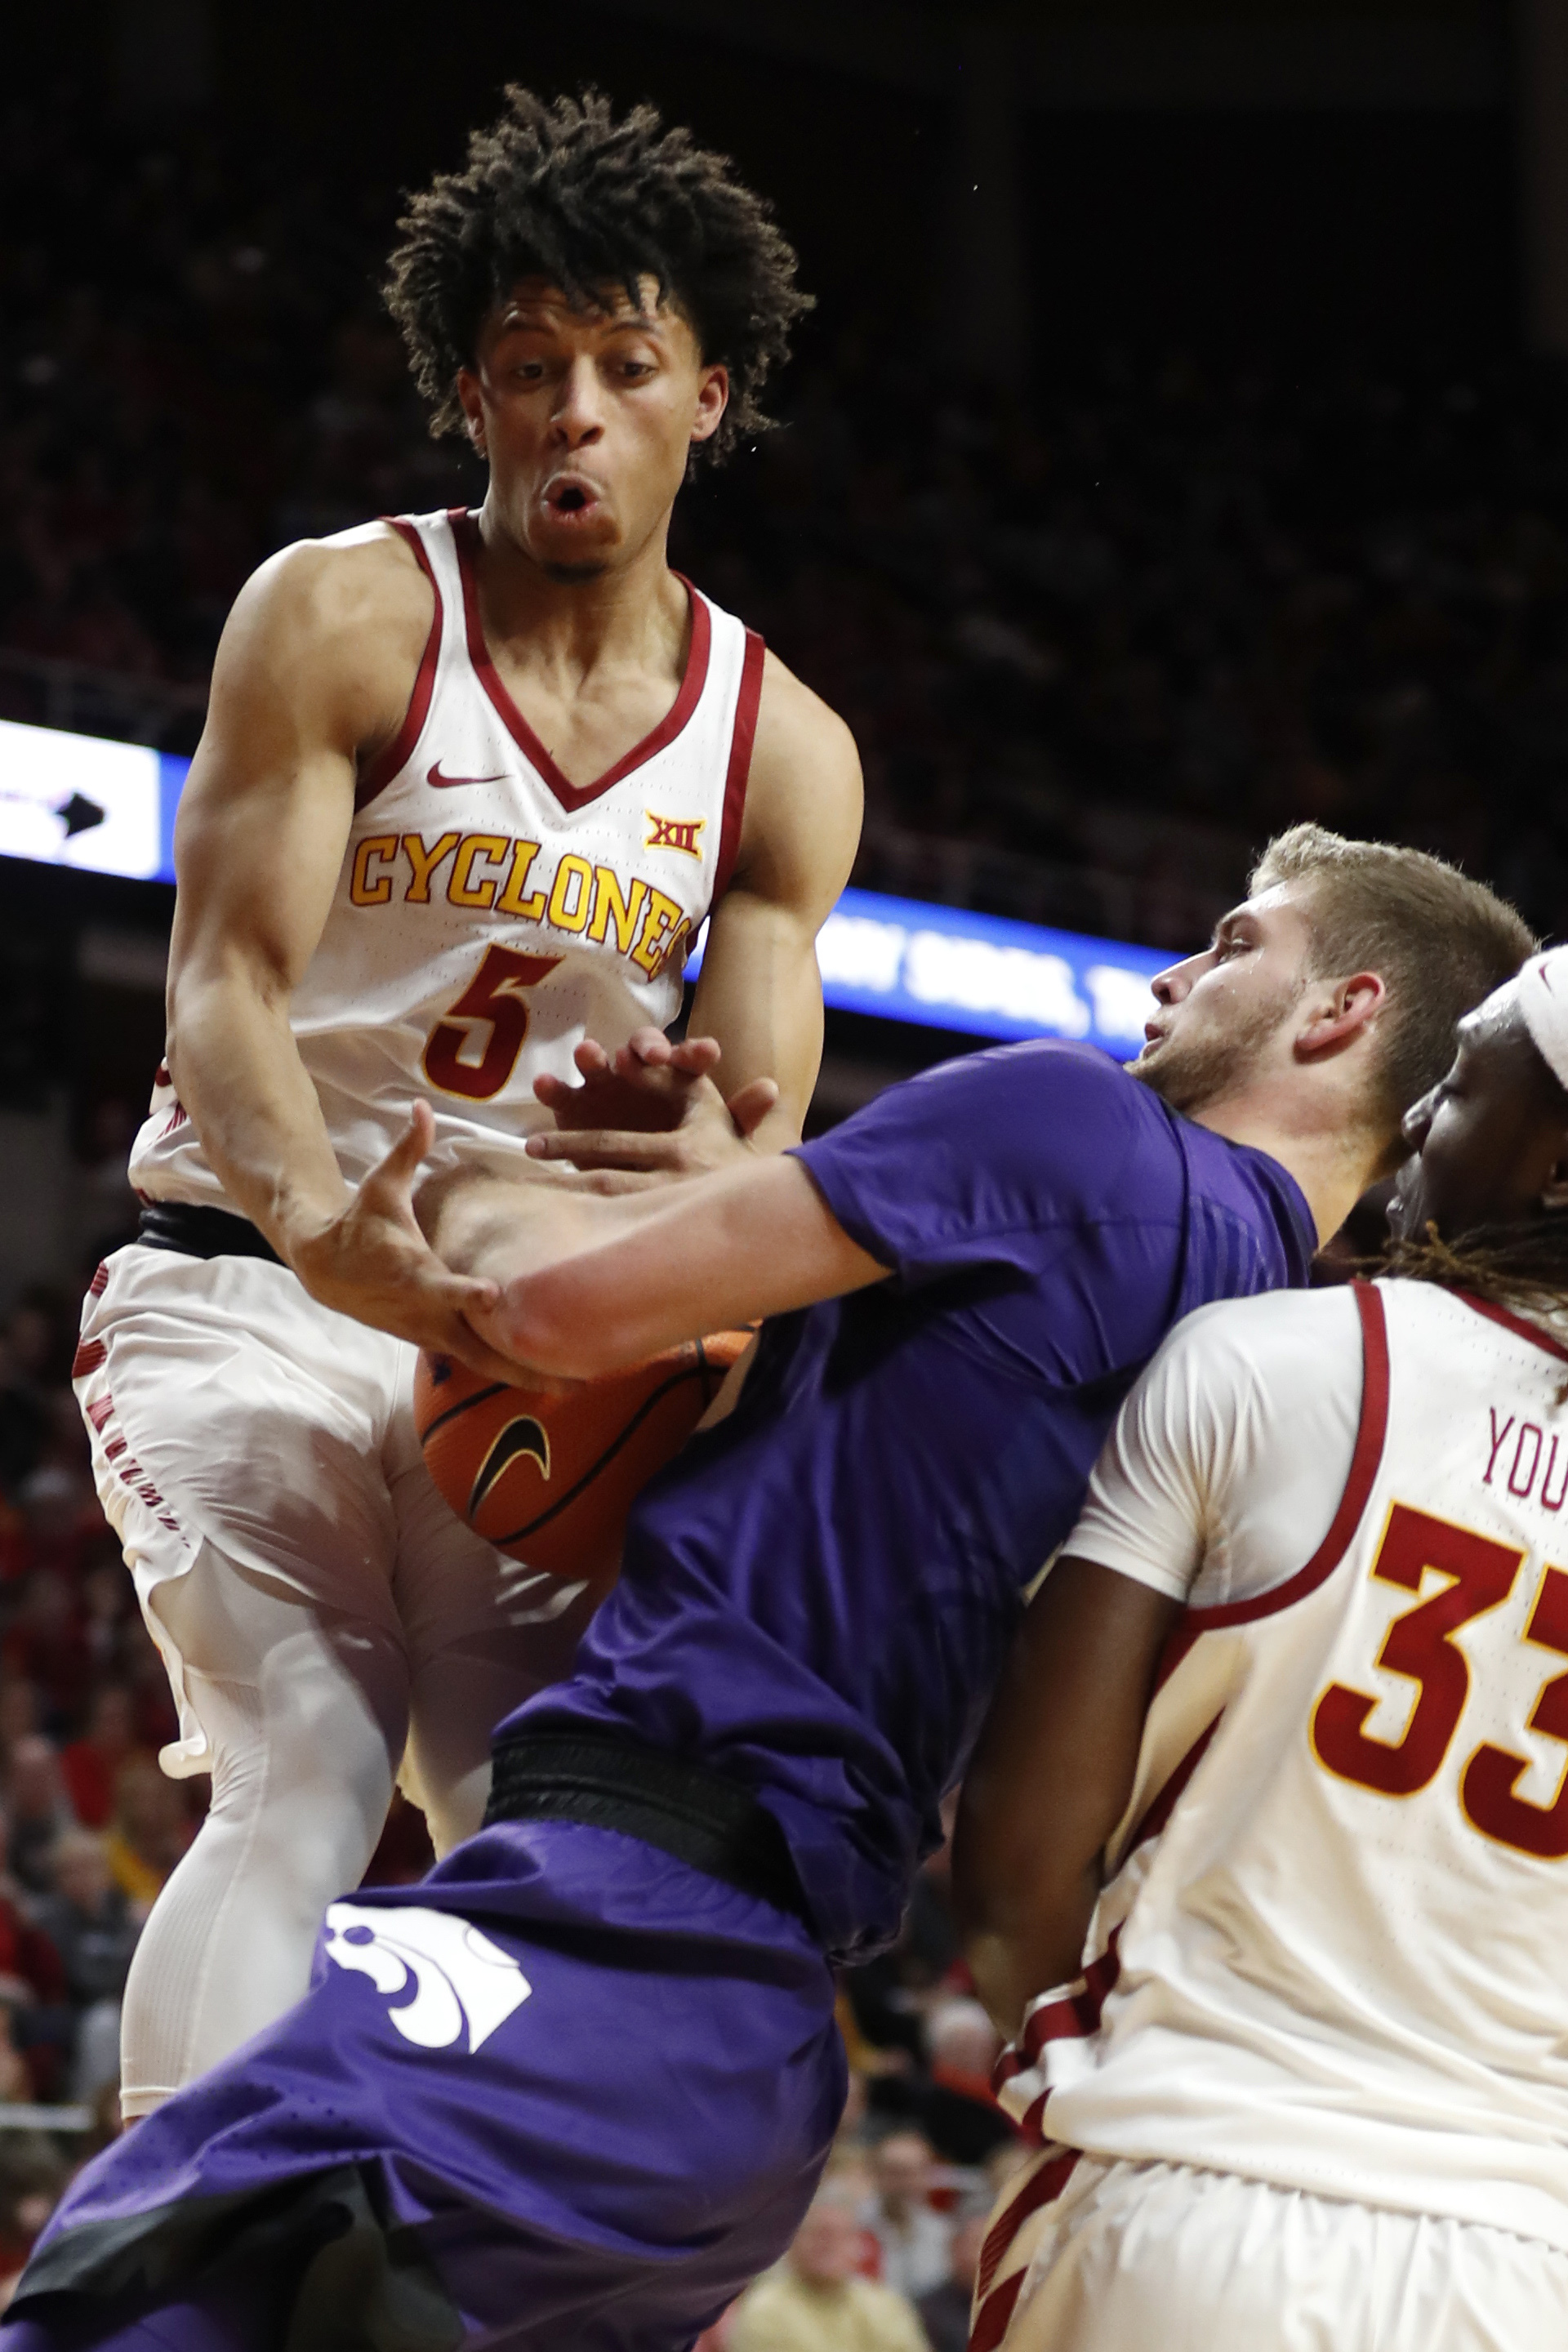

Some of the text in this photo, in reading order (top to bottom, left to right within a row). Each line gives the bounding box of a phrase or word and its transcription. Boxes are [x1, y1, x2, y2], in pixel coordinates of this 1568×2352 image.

[645, 811, 705, 858] XII
[421, 942, 566, 1103] 5
[1482, 1406, 1568, 1512] YOU
